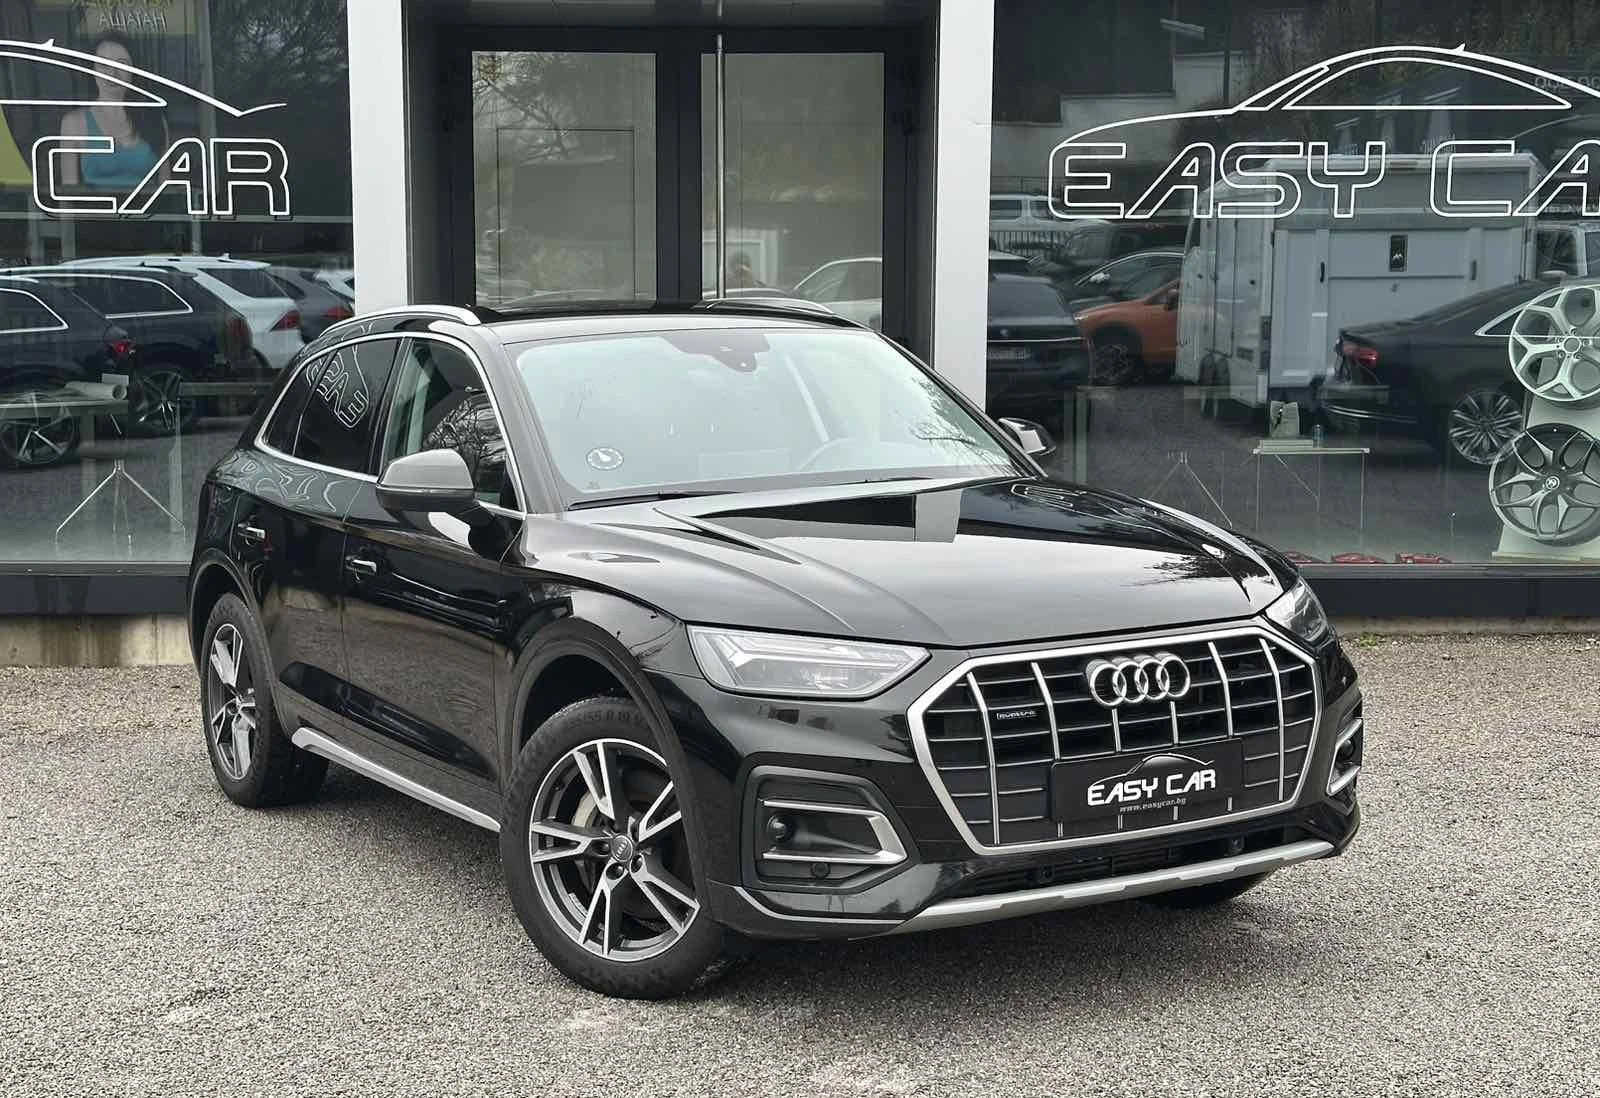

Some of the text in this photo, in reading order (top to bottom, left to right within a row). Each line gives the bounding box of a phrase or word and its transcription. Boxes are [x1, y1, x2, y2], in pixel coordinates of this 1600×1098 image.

[32, 136, 291, 216] CAR
[1048, 141, 1386, 219] EASY
[1087, 769, 1216, 806] EASY CAR
[1119, 797, 1187, 812] www.easycar.bg
